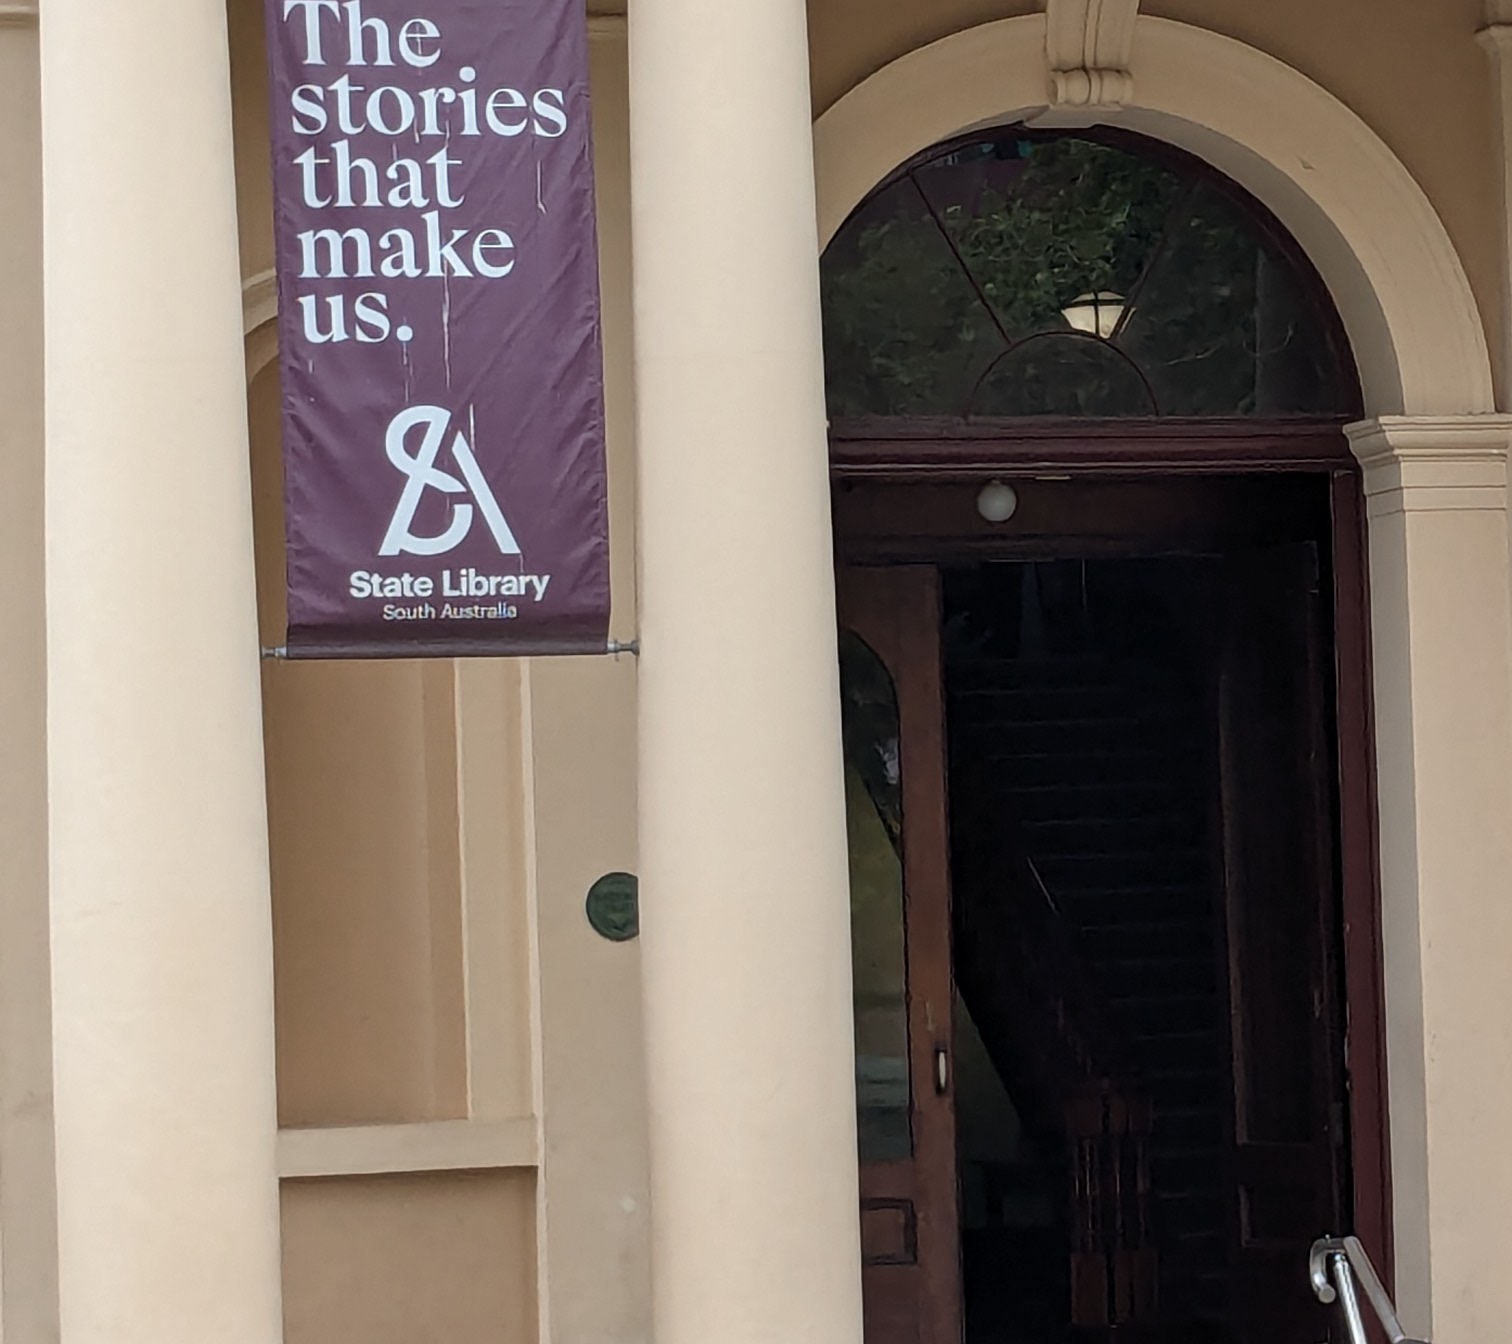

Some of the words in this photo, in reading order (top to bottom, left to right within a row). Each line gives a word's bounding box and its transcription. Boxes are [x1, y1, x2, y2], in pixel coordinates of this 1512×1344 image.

[291, 66, 567, 137] stories
[293, 138, 464, 208] that
[297, 209, 515, 278] make
[297, 292, 413, 343] us.
[349, 570, 434, 598] State
[442, 567, 550, 602] Library
[382, 602, 436, 621] South
[439, 601, 517, 620] Australia
